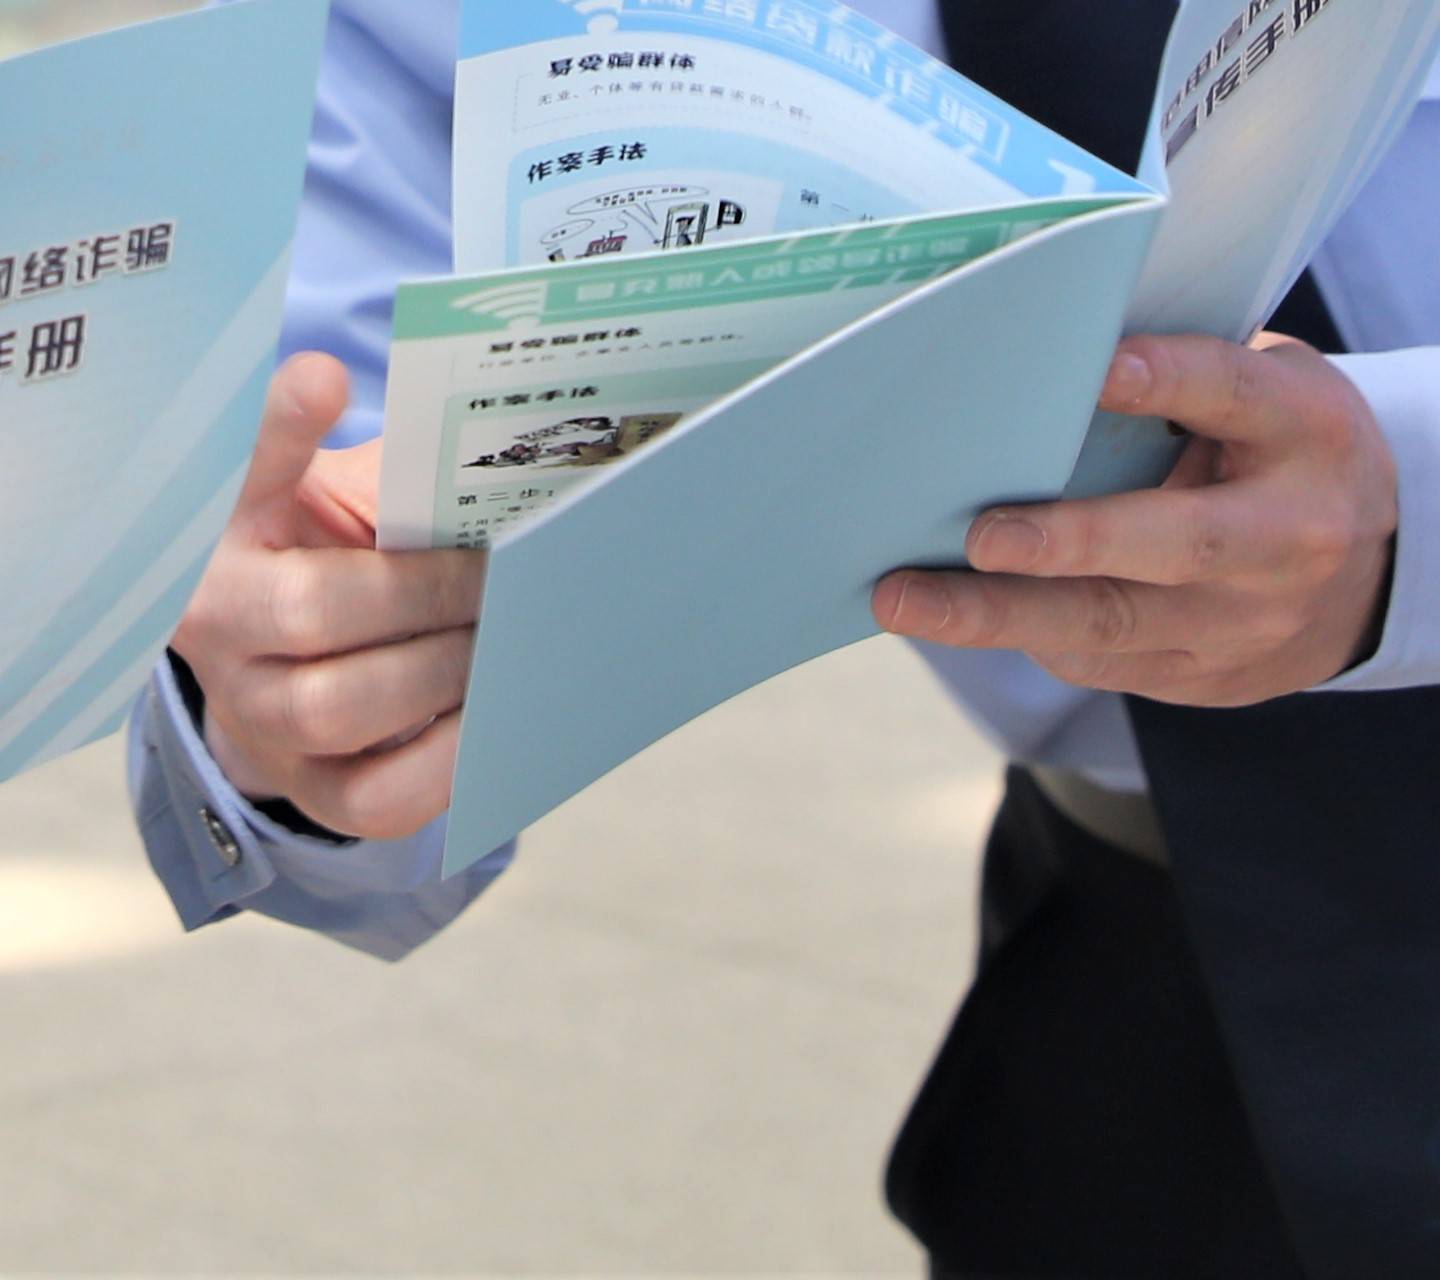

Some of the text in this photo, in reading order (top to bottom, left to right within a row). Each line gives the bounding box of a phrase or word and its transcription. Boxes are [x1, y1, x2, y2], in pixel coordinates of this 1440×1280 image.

[548, 51, 696, 79] 易受骗群体
[526, 141, 648, 184] 作案手法
